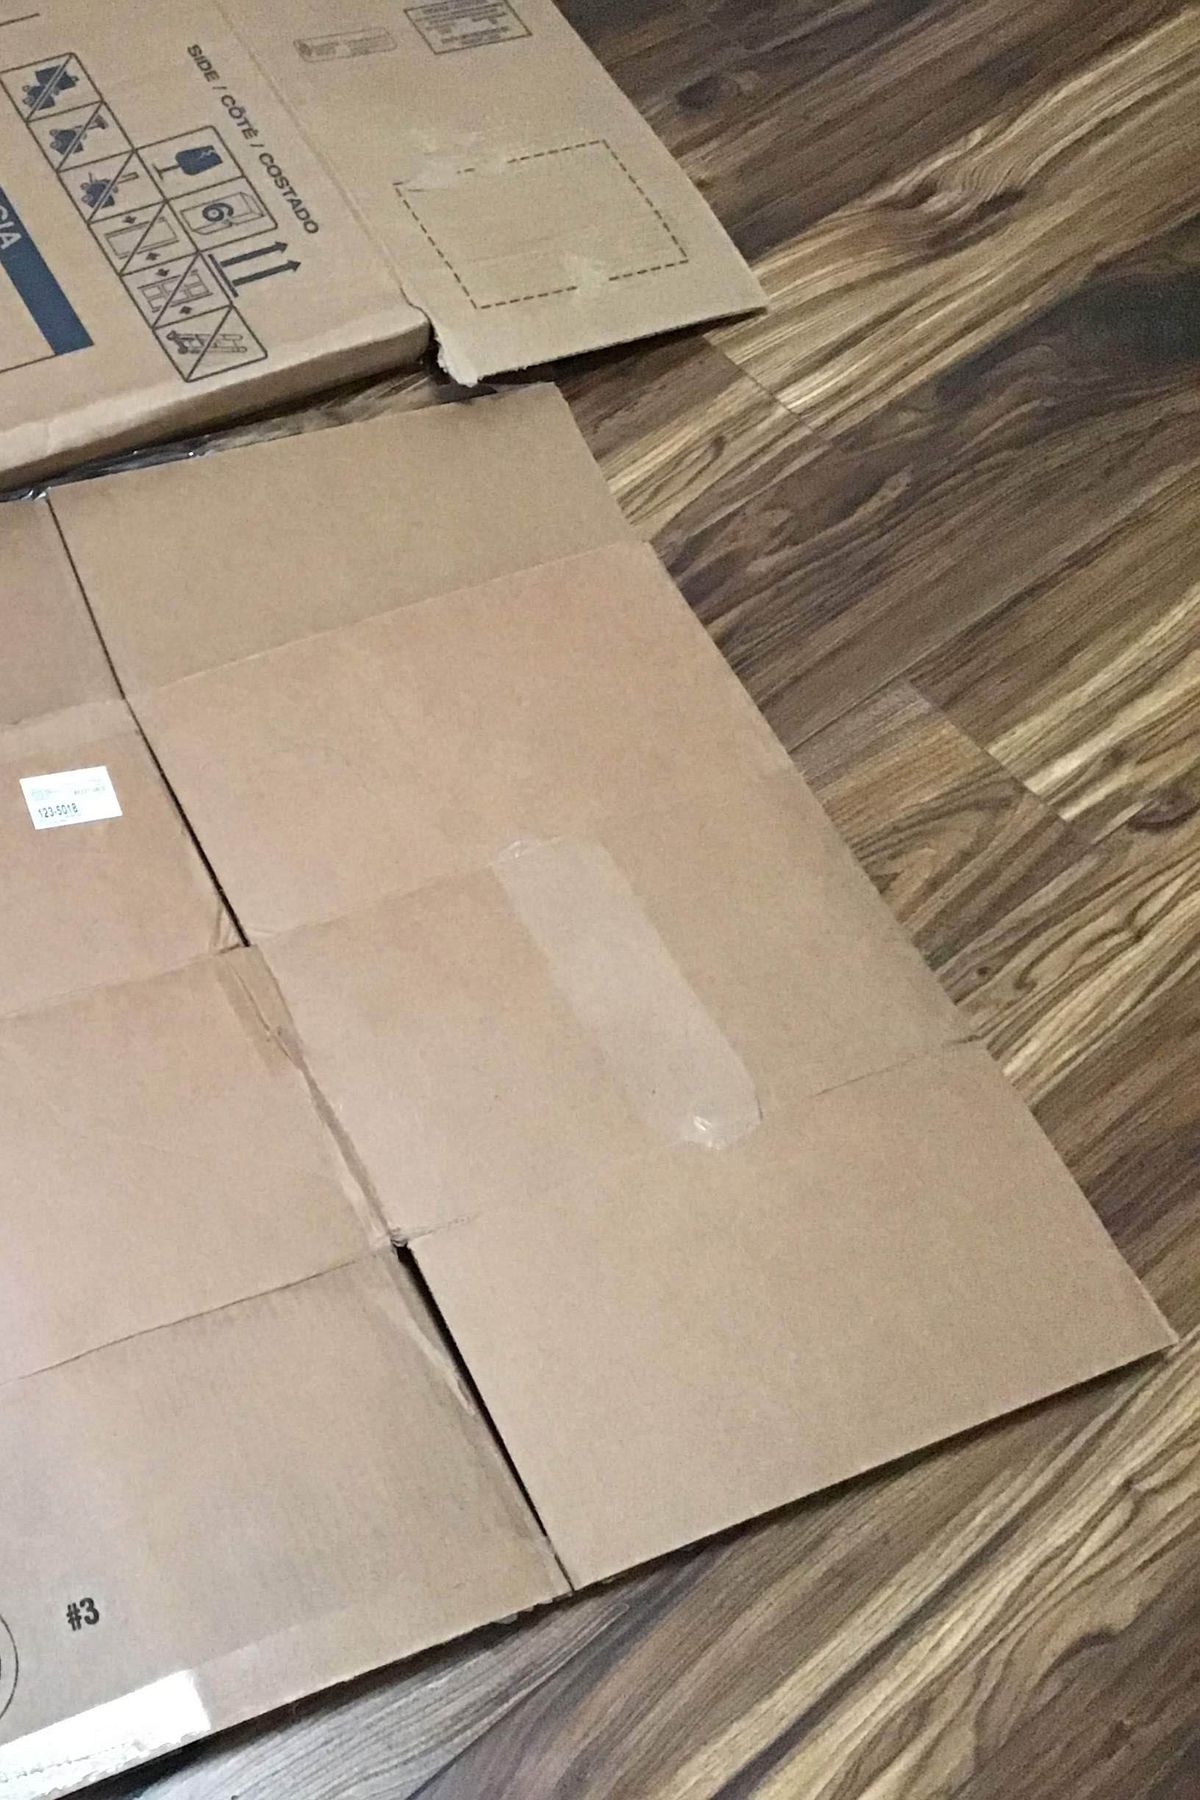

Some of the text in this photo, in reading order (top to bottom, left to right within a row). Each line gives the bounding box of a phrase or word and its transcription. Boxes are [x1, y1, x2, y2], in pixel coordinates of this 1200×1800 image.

[188, 45, 219, 82] SIDE
[221, 95, 258, 139] CÔTÉ
[259, 153, 319, 233] COSTADO
[66, 1597, 100, 1631] #3
